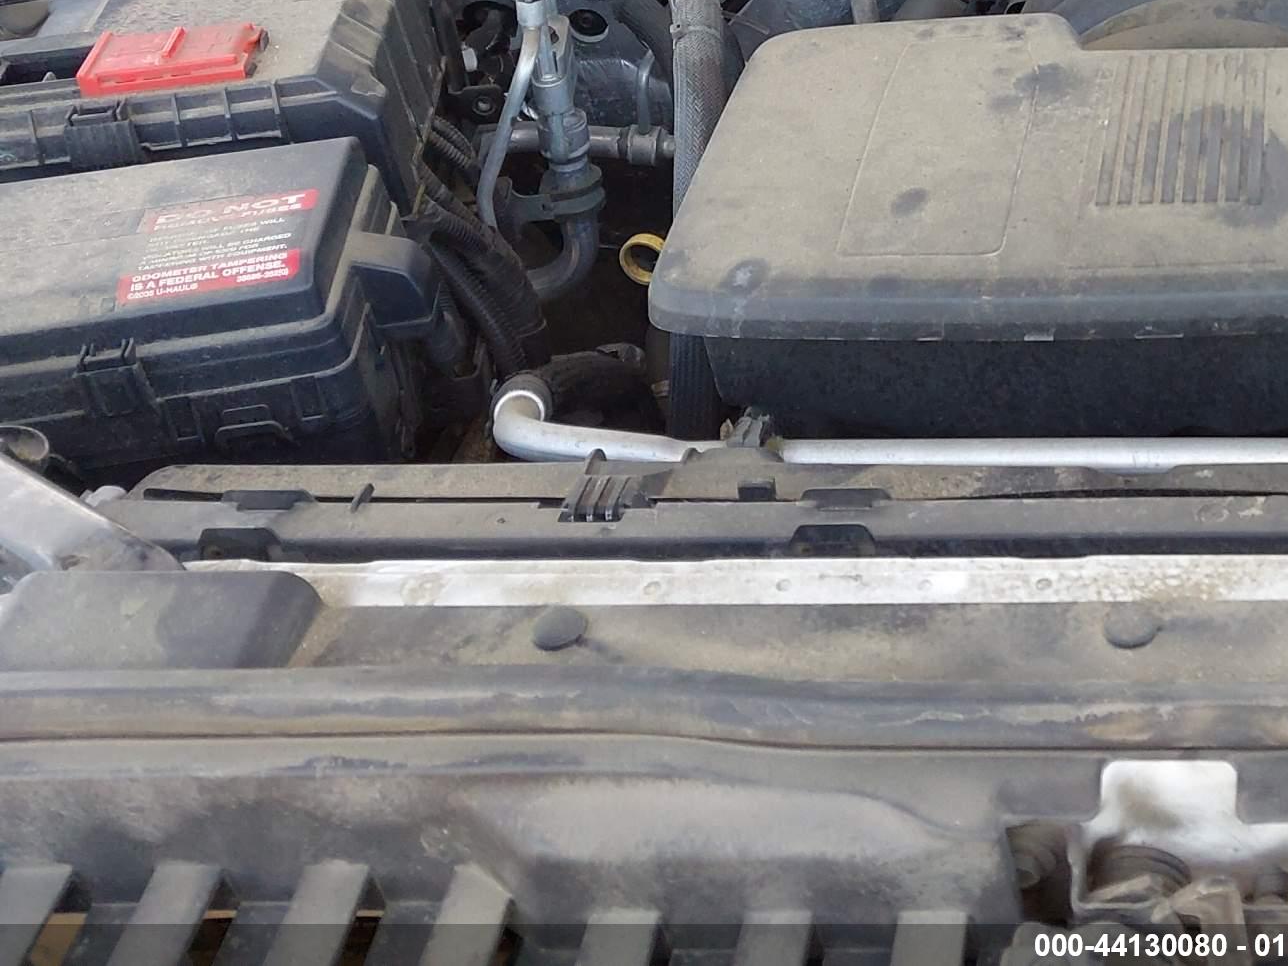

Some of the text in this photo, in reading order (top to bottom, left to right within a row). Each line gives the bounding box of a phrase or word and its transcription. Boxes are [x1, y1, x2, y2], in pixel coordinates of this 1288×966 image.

[223, 194, 305, 214] NOT
[130, 281, 145, 292] IS
[145, 280, 156, 290] A
[158, 271, 219, 287] FEDERAL
[222, 260, 286, 277] OFFENSE.
[132, 252, 288, 283] ODOMETER TAMPERING
